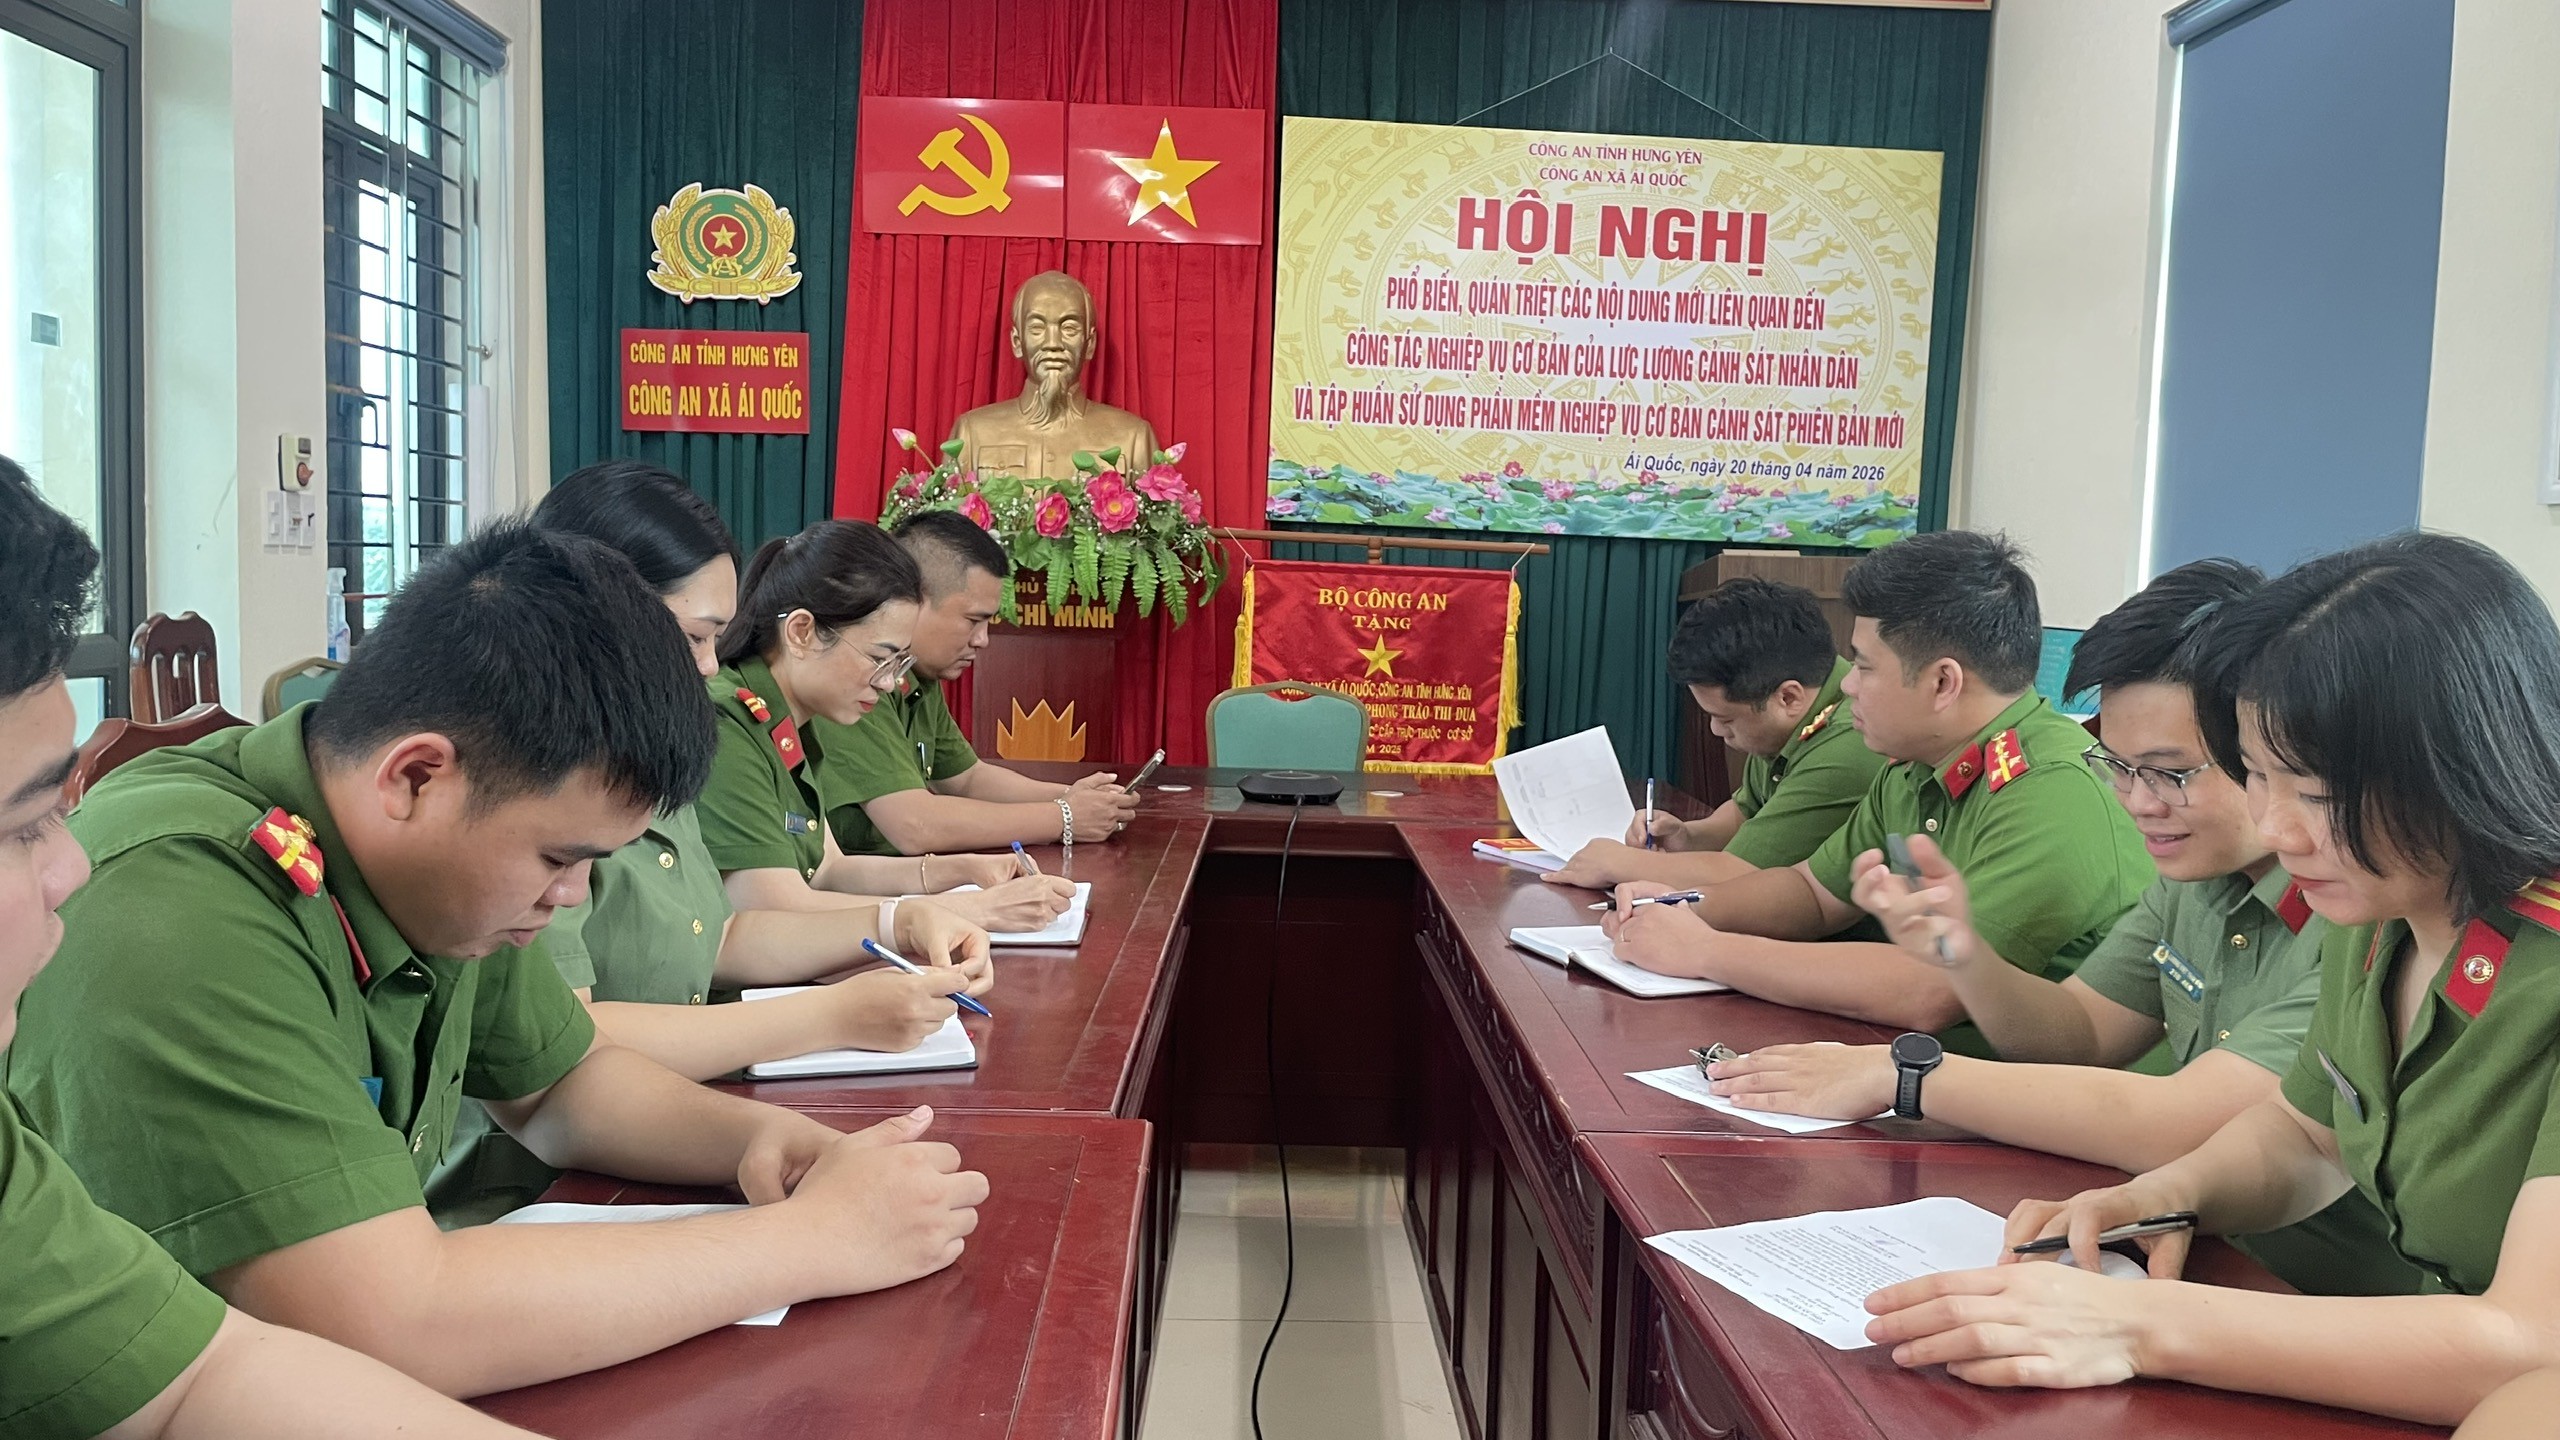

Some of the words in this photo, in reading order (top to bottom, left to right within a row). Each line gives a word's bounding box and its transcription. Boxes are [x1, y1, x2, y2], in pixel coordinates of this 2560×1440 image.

[1528, 140, 1567, 157] CÔNG
[1572, 145, 1592, 159] AN
[1596, 142, 1627, 160] TỈNH
[1675, 148, 1702, 165] YÊN
[1540, 164, 1578, 182] CÔNG
[1582, 169, 1603, 182] AN
[1606, 168, 1626, 184] XÃ
[1649, 168, 1688, 187] QUỐC
[1456, 188, 1574, 265] HỘI
[1598, 205, 1768, 277] NGHỊ
[1386, 265, 1420, 311] PHỔ
[1422, 269, 1463, 316] BIẾN,
[1468, 275, 1511, 317] QUÁN
[1515, 277, 1557, 324] TRIỆT
[1560, 279, 1592, 320] CÁC
[1596, 281, 1624, 328] NỘI
[1627, 289, 1671, 323] DUNG
[1674, 285, 1705, 325] MỚI
[1709, 286, 1744, 327] LIÊN
[1747, 294, 1790, 331] QUAN
[1793, 287, 1825, 331] ĐẾN
[630, 339, 666, 365] CÔNG
[671, 343, 691, 365] AN
[696, 338, 726, 366] TỈNH
[732, 343, 769, 367] HƯNG
[773, 342, 798, 368] YÊN
[1346, 326, 1389, 367] CÔNG
[1394, 328, 1422, 369] TÁC
[1426, 332, 1484, 378] NGHIỆP
[1489, 340, 1508, 380] VỤ
[1512, 338, 1535, 374] CƠ
[1537, 332, 1570, 376] BẢN
[1574, 334, 1604, 377] CỦA
[1609, 343, 1639, 386] LỰC
[1643, 345, 1694, 388] LƯỢNG
[1699, 339, 1741, 384] CẢNH
[1744, 345, 1775, 386] SÁT
[1778, 348, 1822, 388] NHÂN
[1825, 350, 1859, 390] DÂN
[628, 379, 672, 417] CÔNG
[678, 385, 701, 417] AN
[708, 382, 732, 418] XÃ
[737, 381, 755, 418] ÁI
[761, 380, 802, 421] QUỐC
[1294, 380, 1314, 421] VÀ
[1319, 382, 1348, 429] TẬP
[1351, 380, 1395, 424] HUẤN
[1399, 382, 1422, 426] SỬ
[1423, 394, 1466, 434] DỤNG
[1470, 386, 1514, 430] PHẦN
[1516, 389, 1556, 432] MỀM
[1559, 396, 1617, 442] NGHIỆP
[1621, 404, 1641, 443] VỤ
[1645, 402, 1667, 438] CƠ
[1670, 395, 1703, 439] BẢN
[1706, 397, 1750, 441] CẢNH
[1753, 404, 1784, 443] SÁT
[1786, 406, 1835, 446] PHIÊN
[1836, 403, 1872, 447] BẢN
[1873, 410, 1904, 449] MỚI
[1624, 450, 1640, 470] Ái
[1644, 453, 1686, 474] Quốc,
[1690, 459, 1726, 477] ngày
[1730, 459, 1746, 475] 20
[1750, 460, 1791, 479] tháng
[1795, 462, 1813, 477] 04
[1816, 464, 1847, 480] năm
[1851, 465, 1885, 481] 2026
[1015, 577, 1040, 594] HỦ
[1318, 585, 1349, 612] BỘ
[1353, 587, 1413, 610] CÔNG
[1416, 592, 1447, 611] AN
[1352, 613, 1412, 631] TẶNG
[1401, 684, 1413, 699] AN
[1457, 684, 1472, 701] YÊN
[1365, 703, 1399, 719] PHONG
[1401, 701, 1430, 720] TRÀO
[1433, 705, 1452, 721] THI
